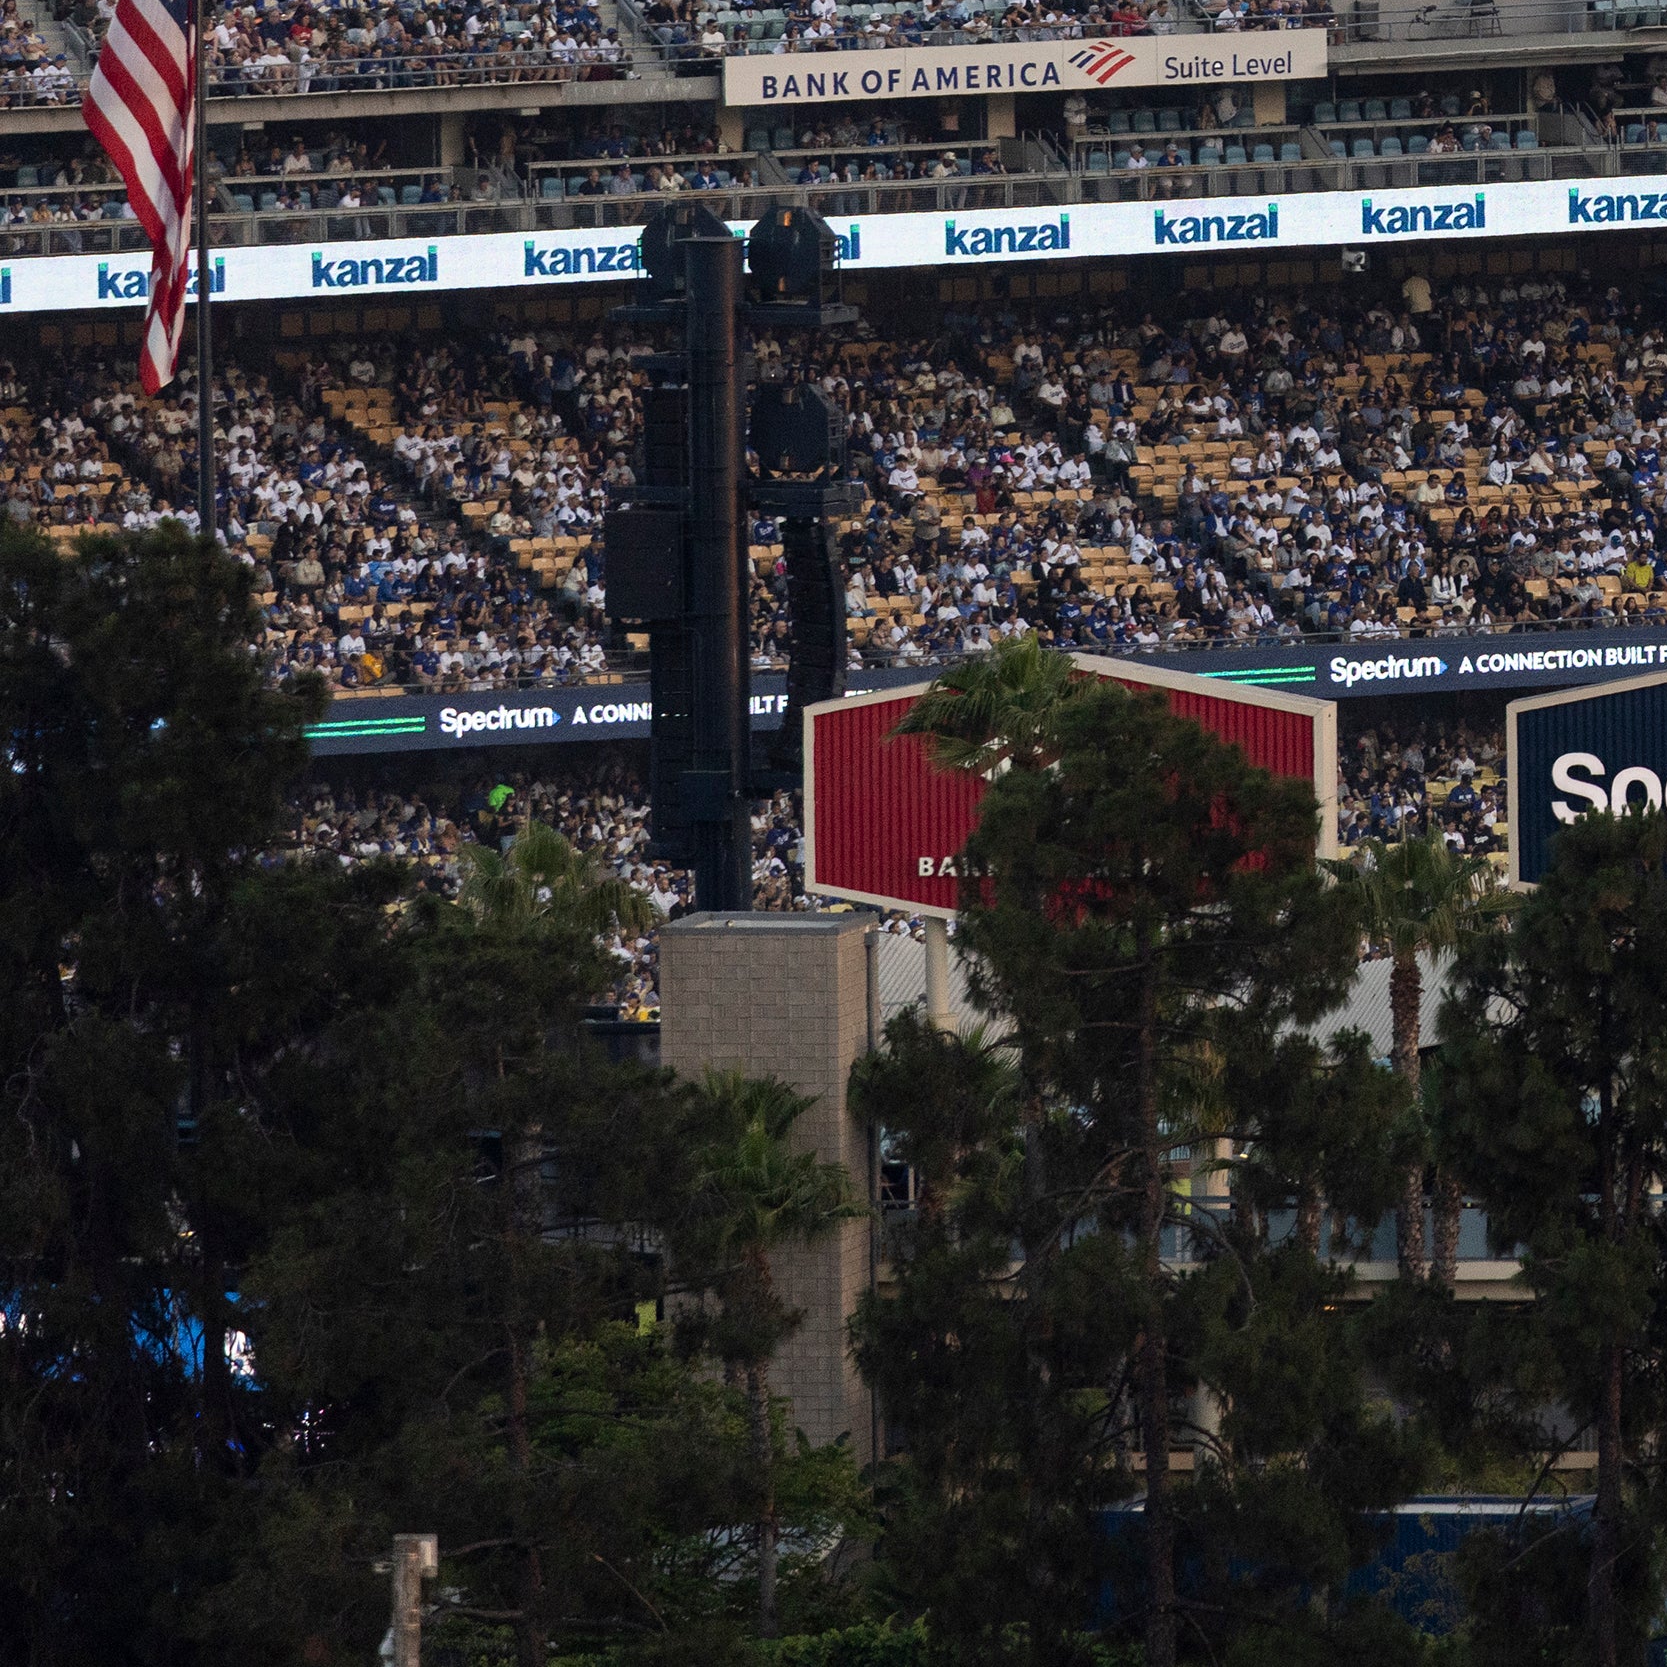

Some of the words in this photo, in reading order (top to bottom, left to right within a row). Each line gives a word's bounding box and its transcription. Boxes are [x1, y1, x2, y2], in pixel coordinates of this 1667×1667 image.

[762, 71, 850, 100] BANK
[861, 67, 902, 95] OF
[912, 61, 1061, 92] AMERICA
[1165, 54, 1225, 80] Suite
[1233, 50, 1292, 77] Level
[1330, 654, 1442, 687] Spectrum
[1458, 656, 1476, 674] A
[1477, 648, 1603, 674] CONNECTION
[1605, 645, 1657, 667] BUILT
[440, 705, 554, 738] Spectrum
[572, 706, 588, 726] A
